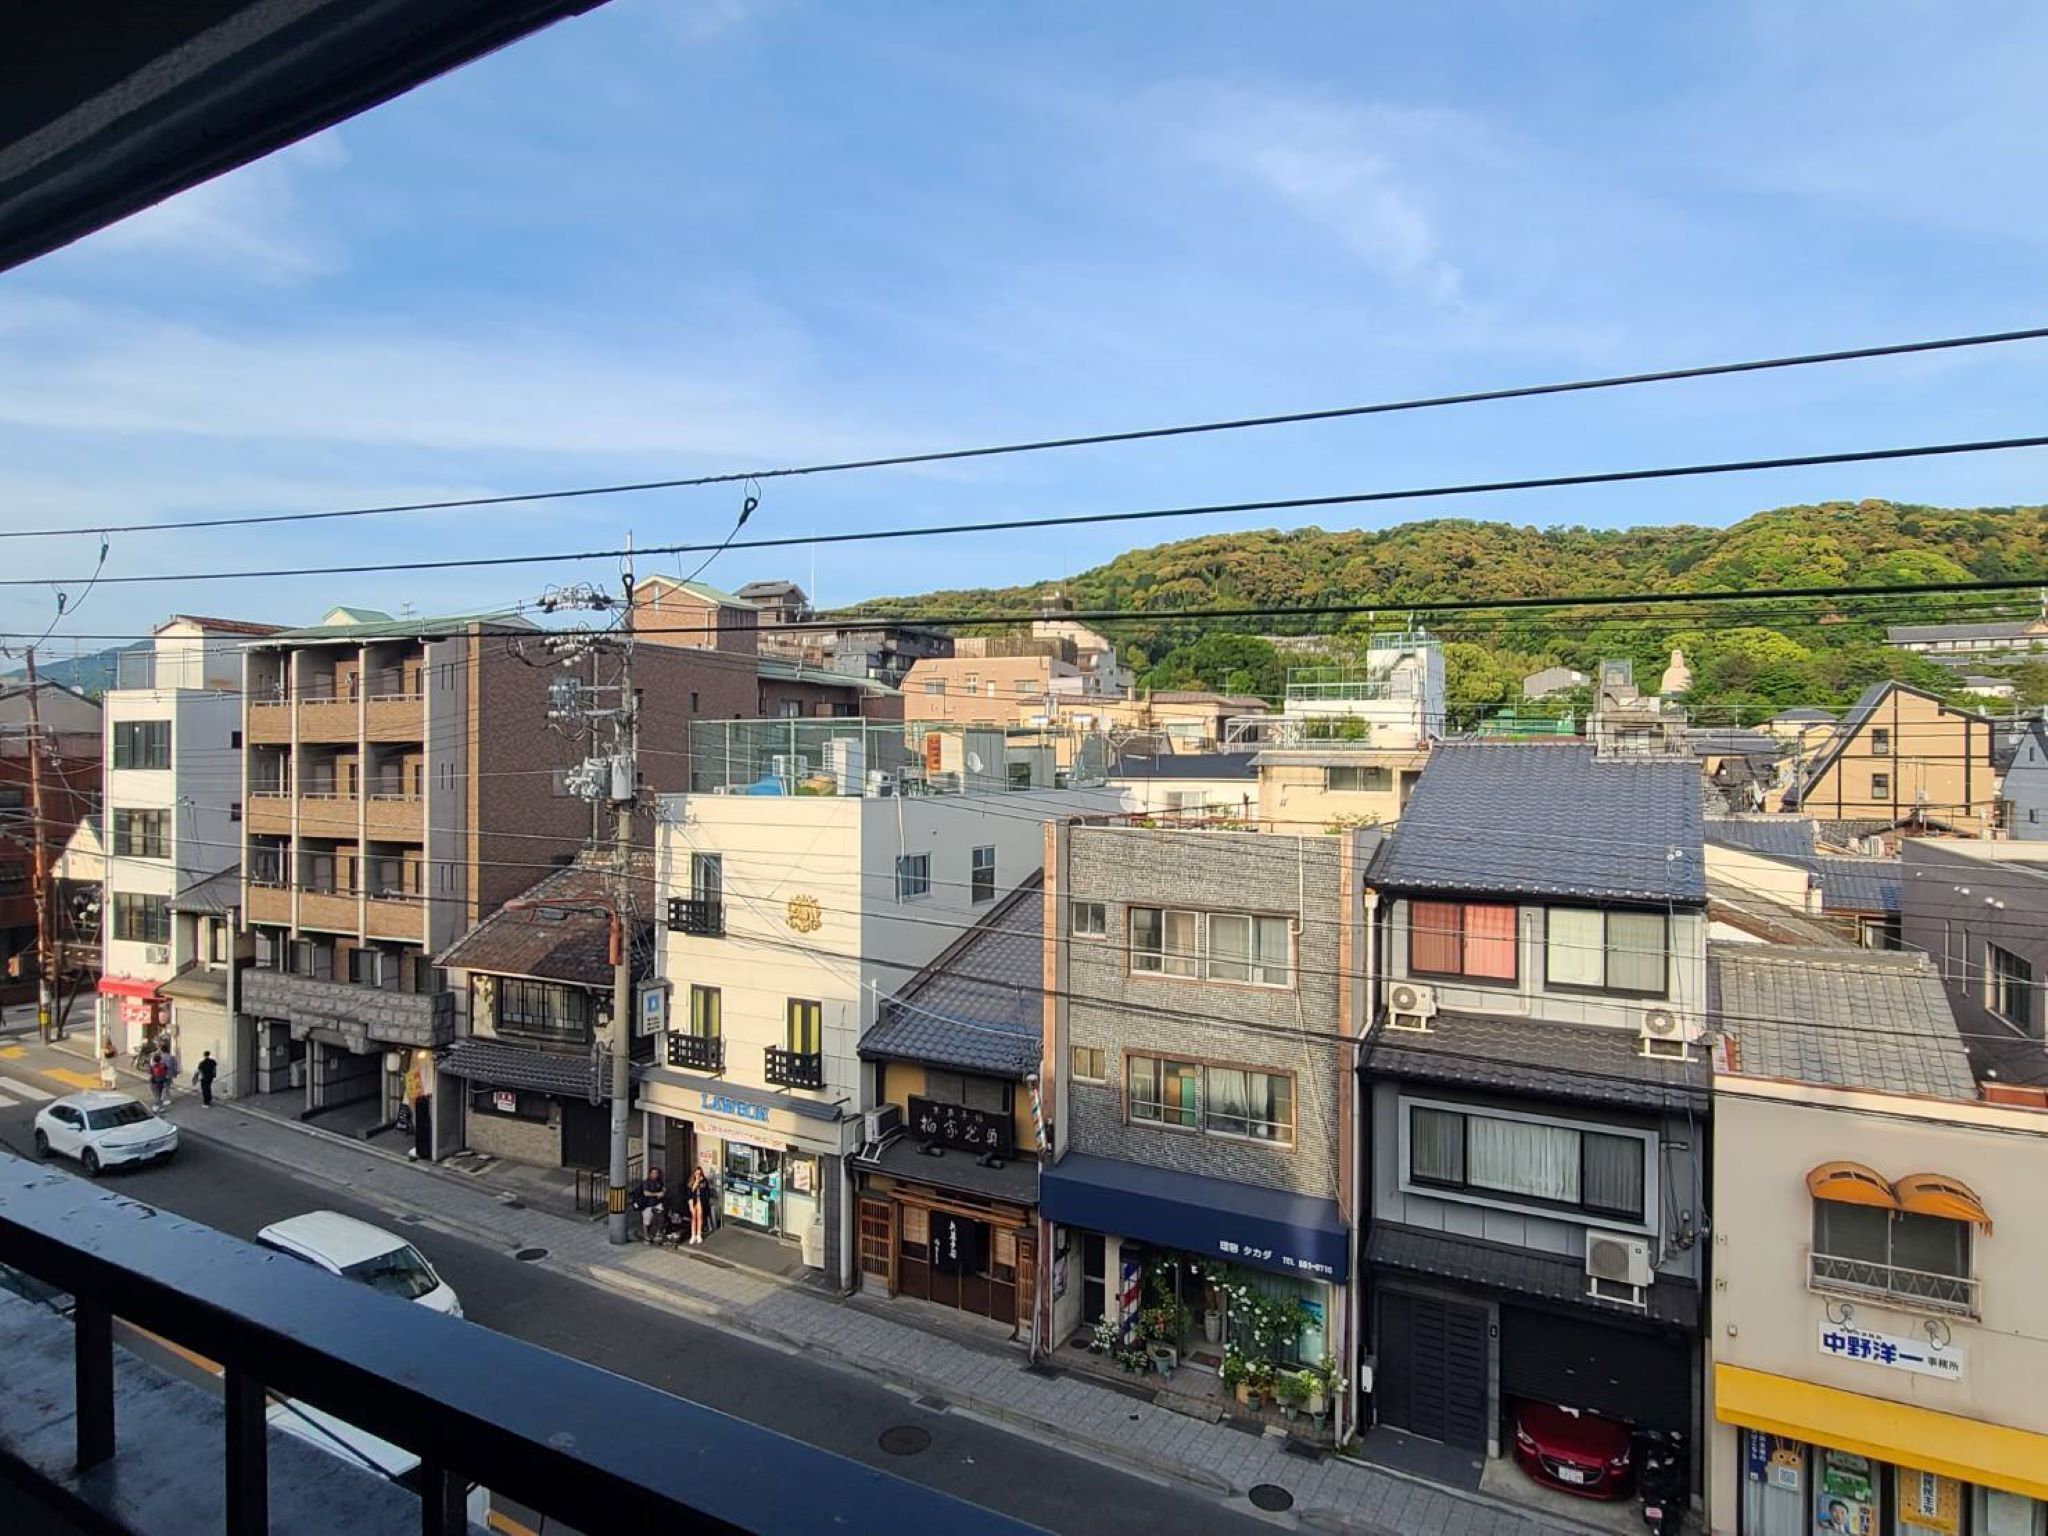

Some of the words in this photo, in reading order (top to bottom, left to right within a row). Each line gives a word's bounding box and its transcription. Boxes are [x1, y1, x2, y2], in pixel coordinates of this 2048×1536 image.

[1243, 1246, 1272, 1260] タカダ
[1282, 1256, 1296, 1266] TEL
[1822, 1331, 1924, 1365] 中野洋一
[1927, 1356, 1960, 1373] 事務所
